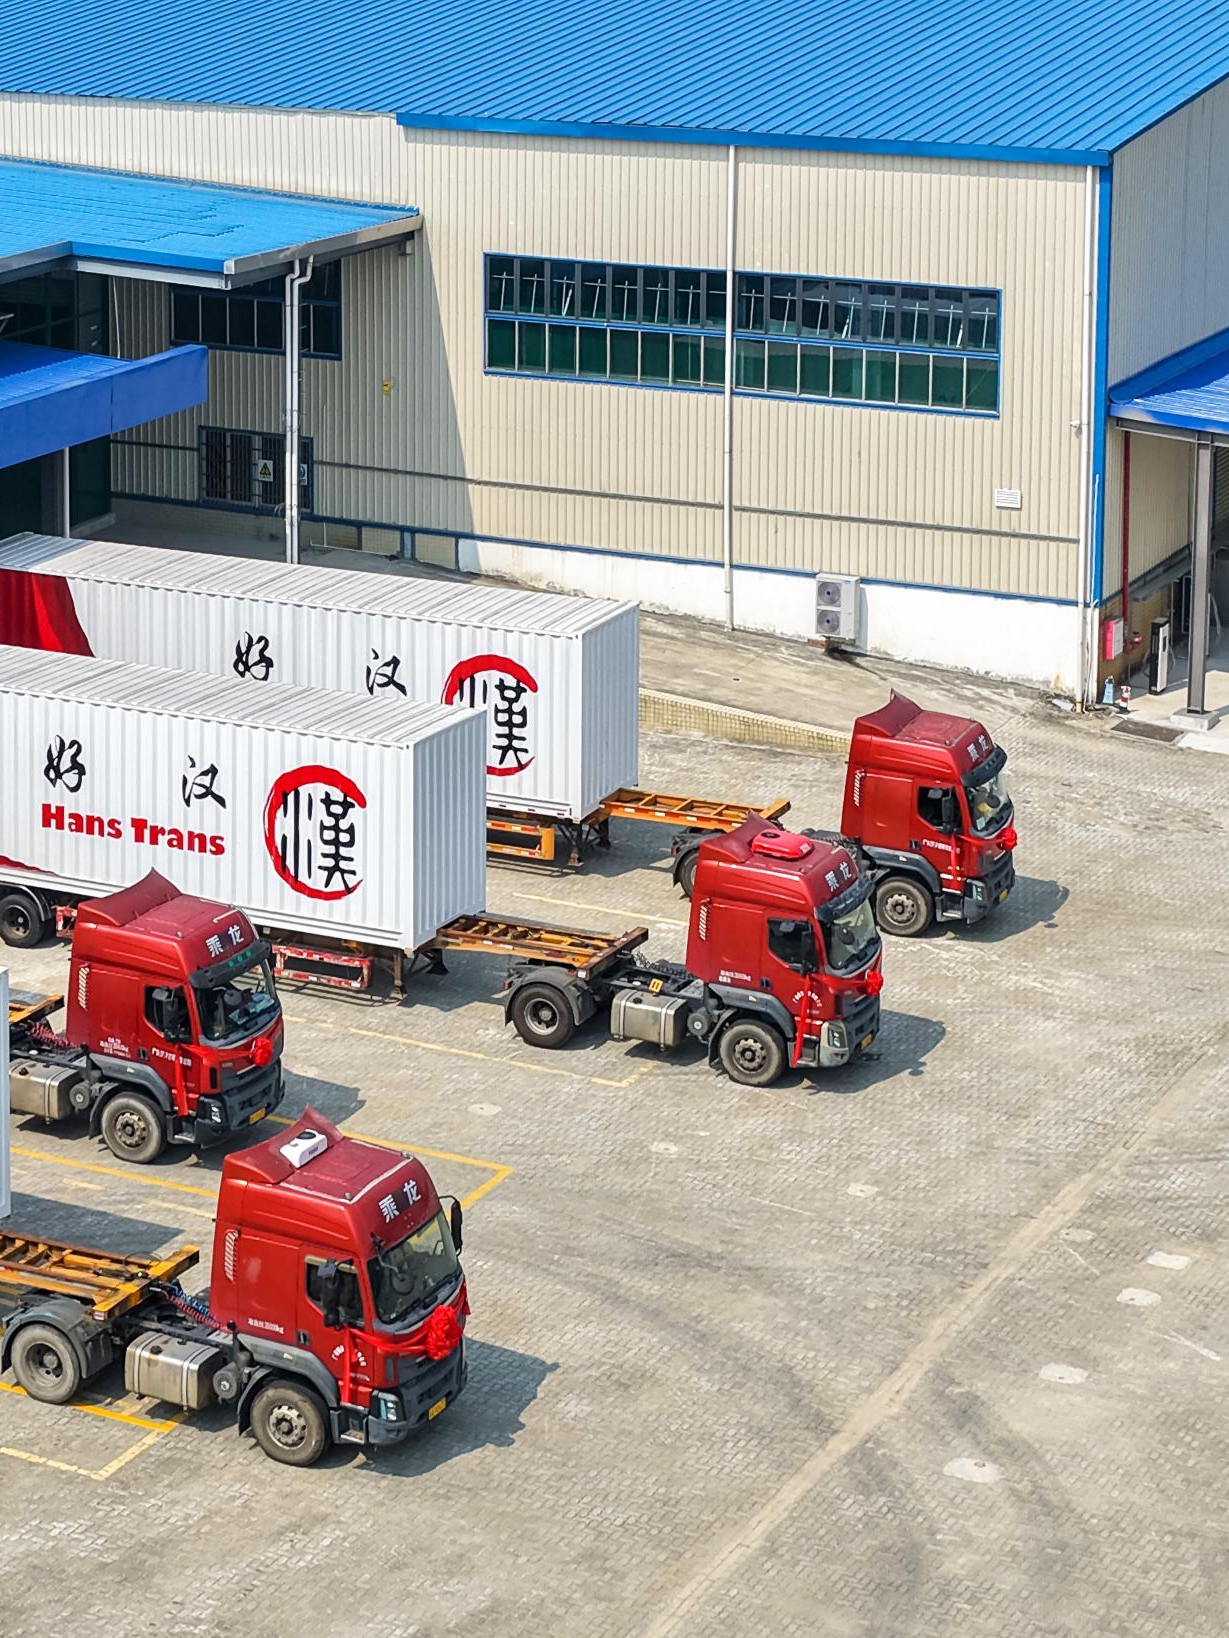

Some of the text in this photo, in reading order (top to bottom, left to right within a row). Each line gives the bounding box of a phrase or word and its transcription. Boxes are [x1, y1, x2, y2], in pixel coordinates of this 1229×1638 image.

[41, 803, 226, 856] Hans Trans
[205, 924, 245, 958] 乘龙
[378, 1179, 422, 1224] 乘龙
